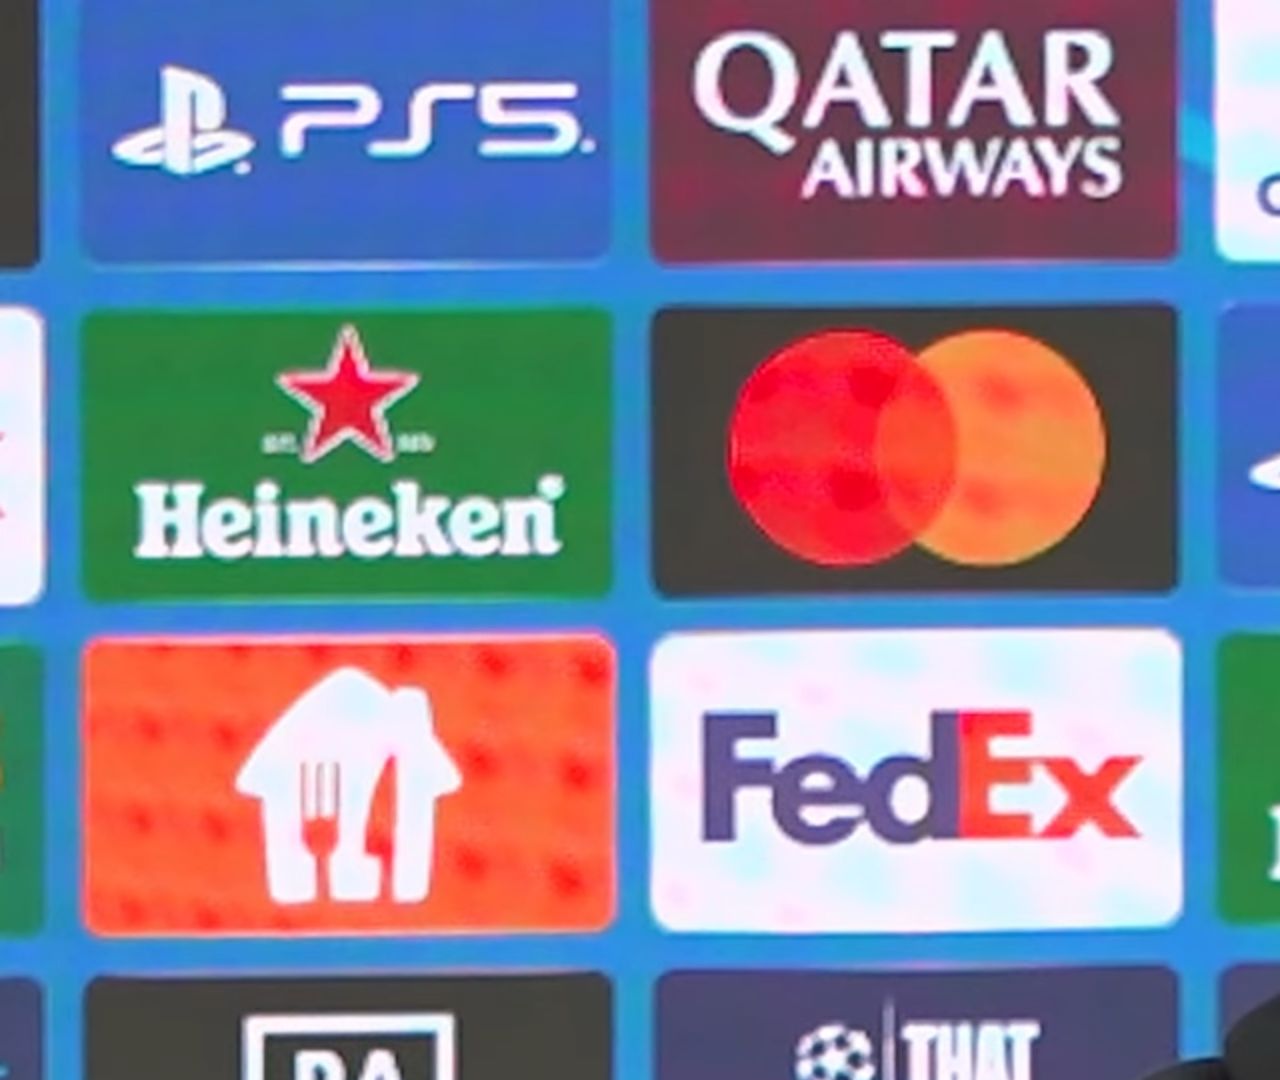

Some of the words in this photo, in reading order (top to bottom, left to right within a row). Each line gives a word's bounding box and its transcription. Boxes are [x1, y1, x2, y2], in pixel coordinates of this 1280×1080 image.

[281, 83, 578, 154] PS5
[695, 30, 1119, 156] QATAR
[803, 137, 1121, 197] AIRWAYS
[135, 474, 563, 558] Heineken
[702, 710, 1140, 845] FedEx
